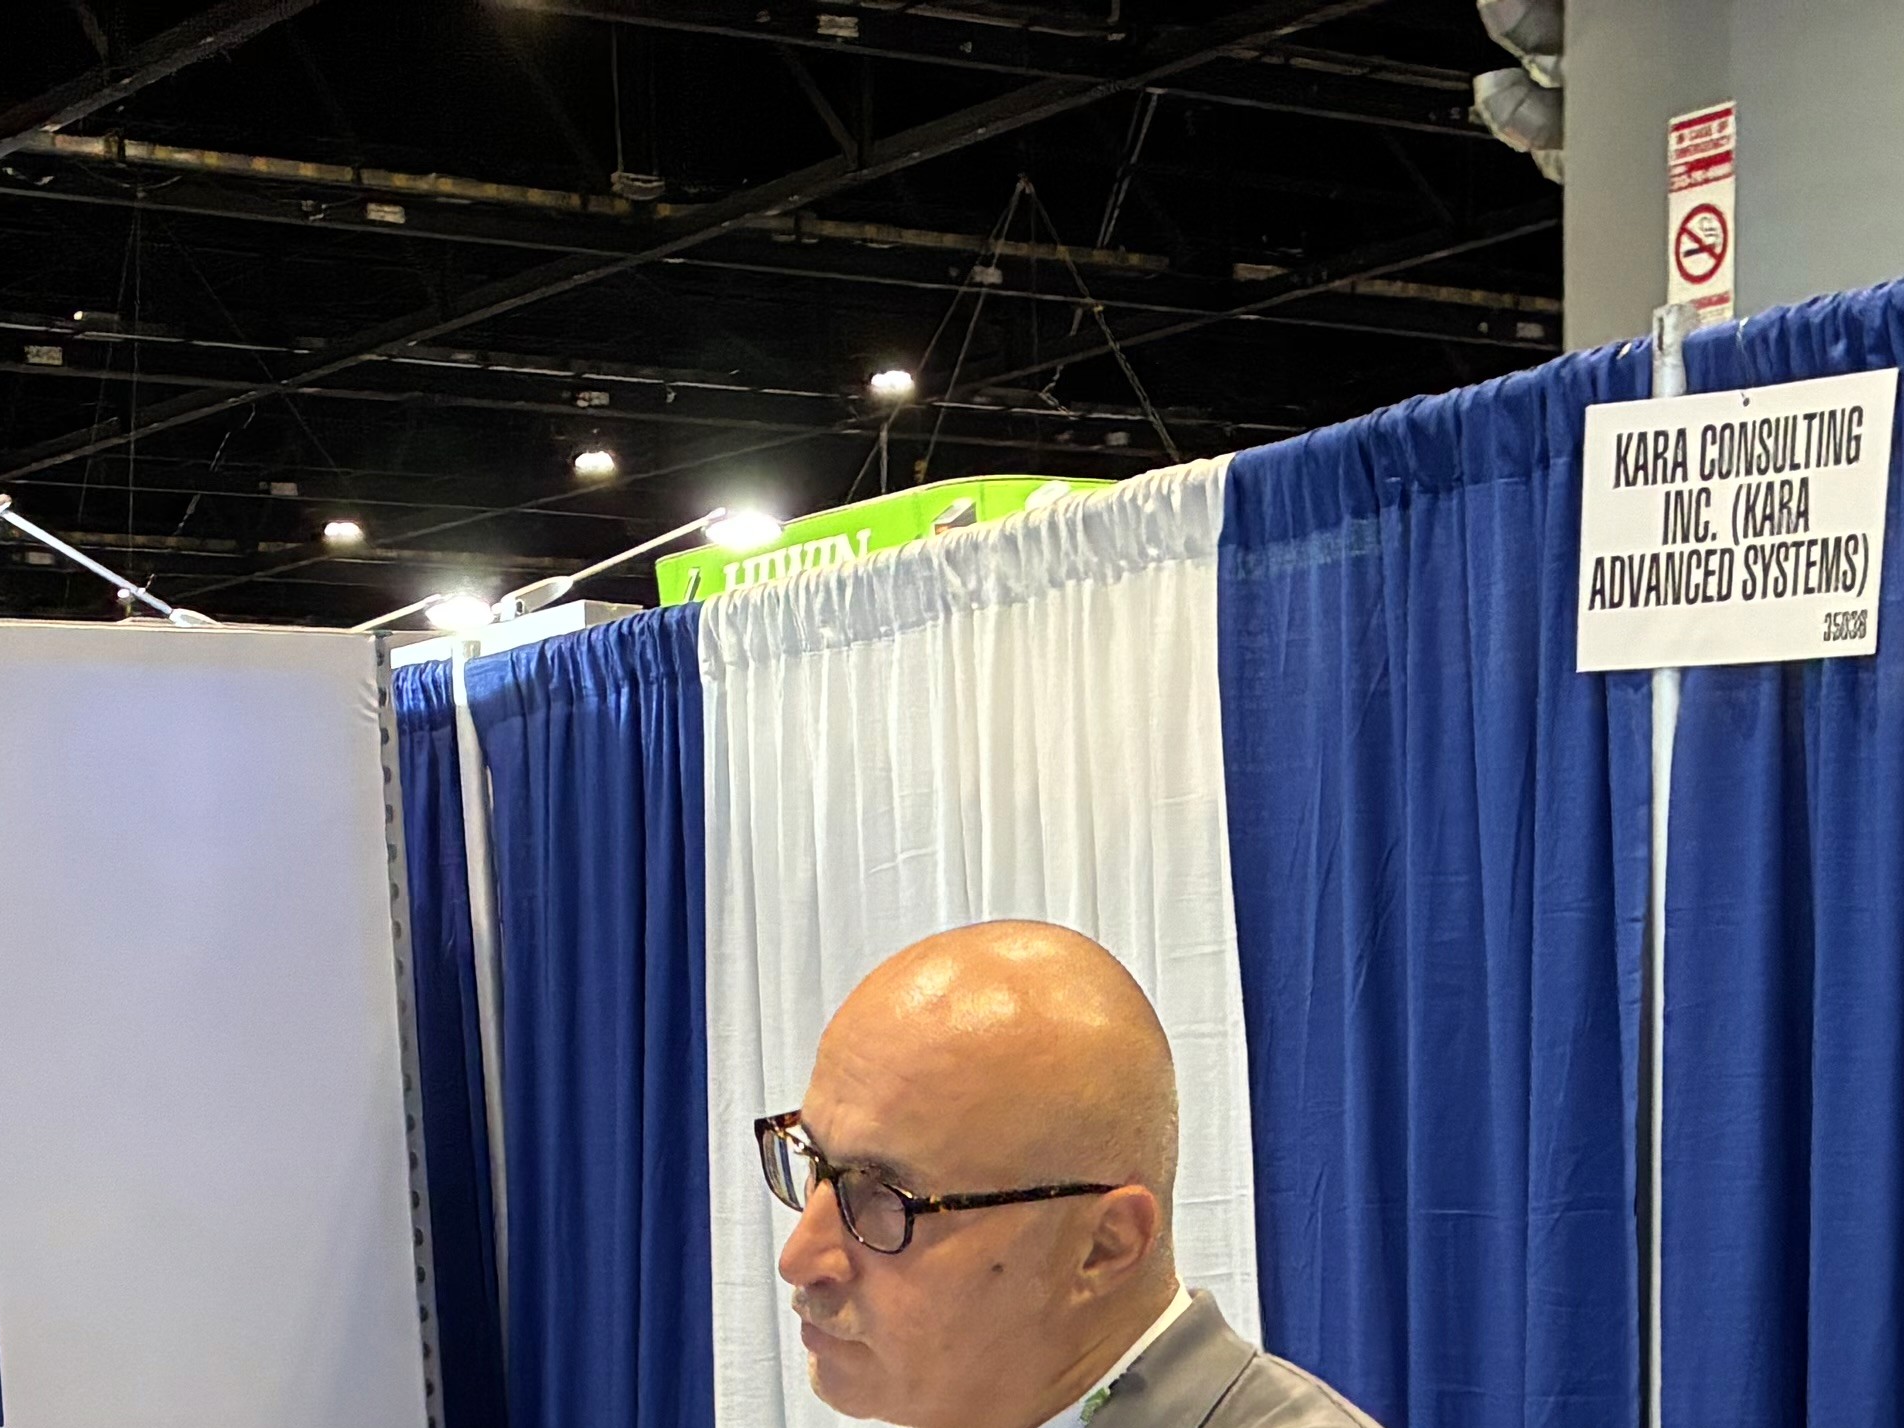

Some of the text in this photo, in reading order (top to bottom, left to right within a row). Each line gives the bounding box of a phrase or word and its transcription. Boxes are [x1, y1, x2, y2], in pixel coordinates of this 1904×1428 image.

[1613, 405, 1864, 489] KARA CONSULTING
[1662, 476, 1810, 545] INC. (KARA
[1588, 533, 1869, 610] ADVANCED SYSTEMS)
